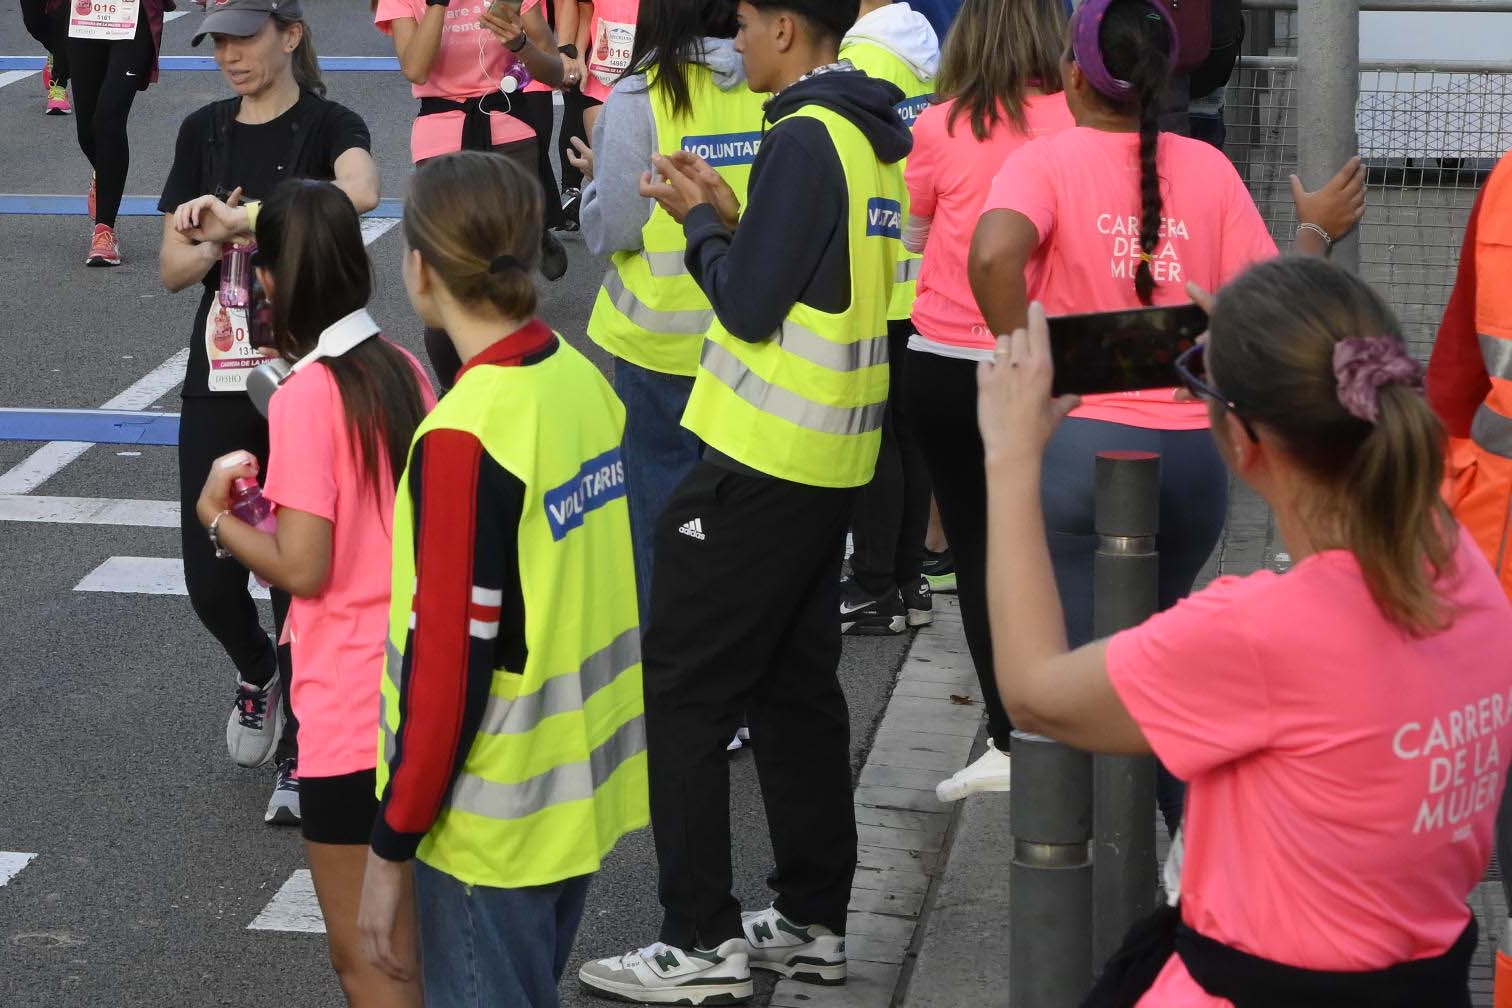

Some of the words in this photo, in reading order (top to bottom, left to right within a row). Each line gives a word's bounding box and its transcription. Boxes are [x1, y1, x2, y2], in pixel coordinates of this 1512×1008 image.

[94, 4, 116, 13] 016
[609, 48, 630, 60] 016
[1097, 213, 1190, 241] CARERA
[1114, 237, 1142, 258] DE
[678, 526, 706, 541] adidas
[1429, 749, 1467, 793] DE
[1474, 736, 1500, 776] LA
[1412, 771, 1498, 835] MUJER
